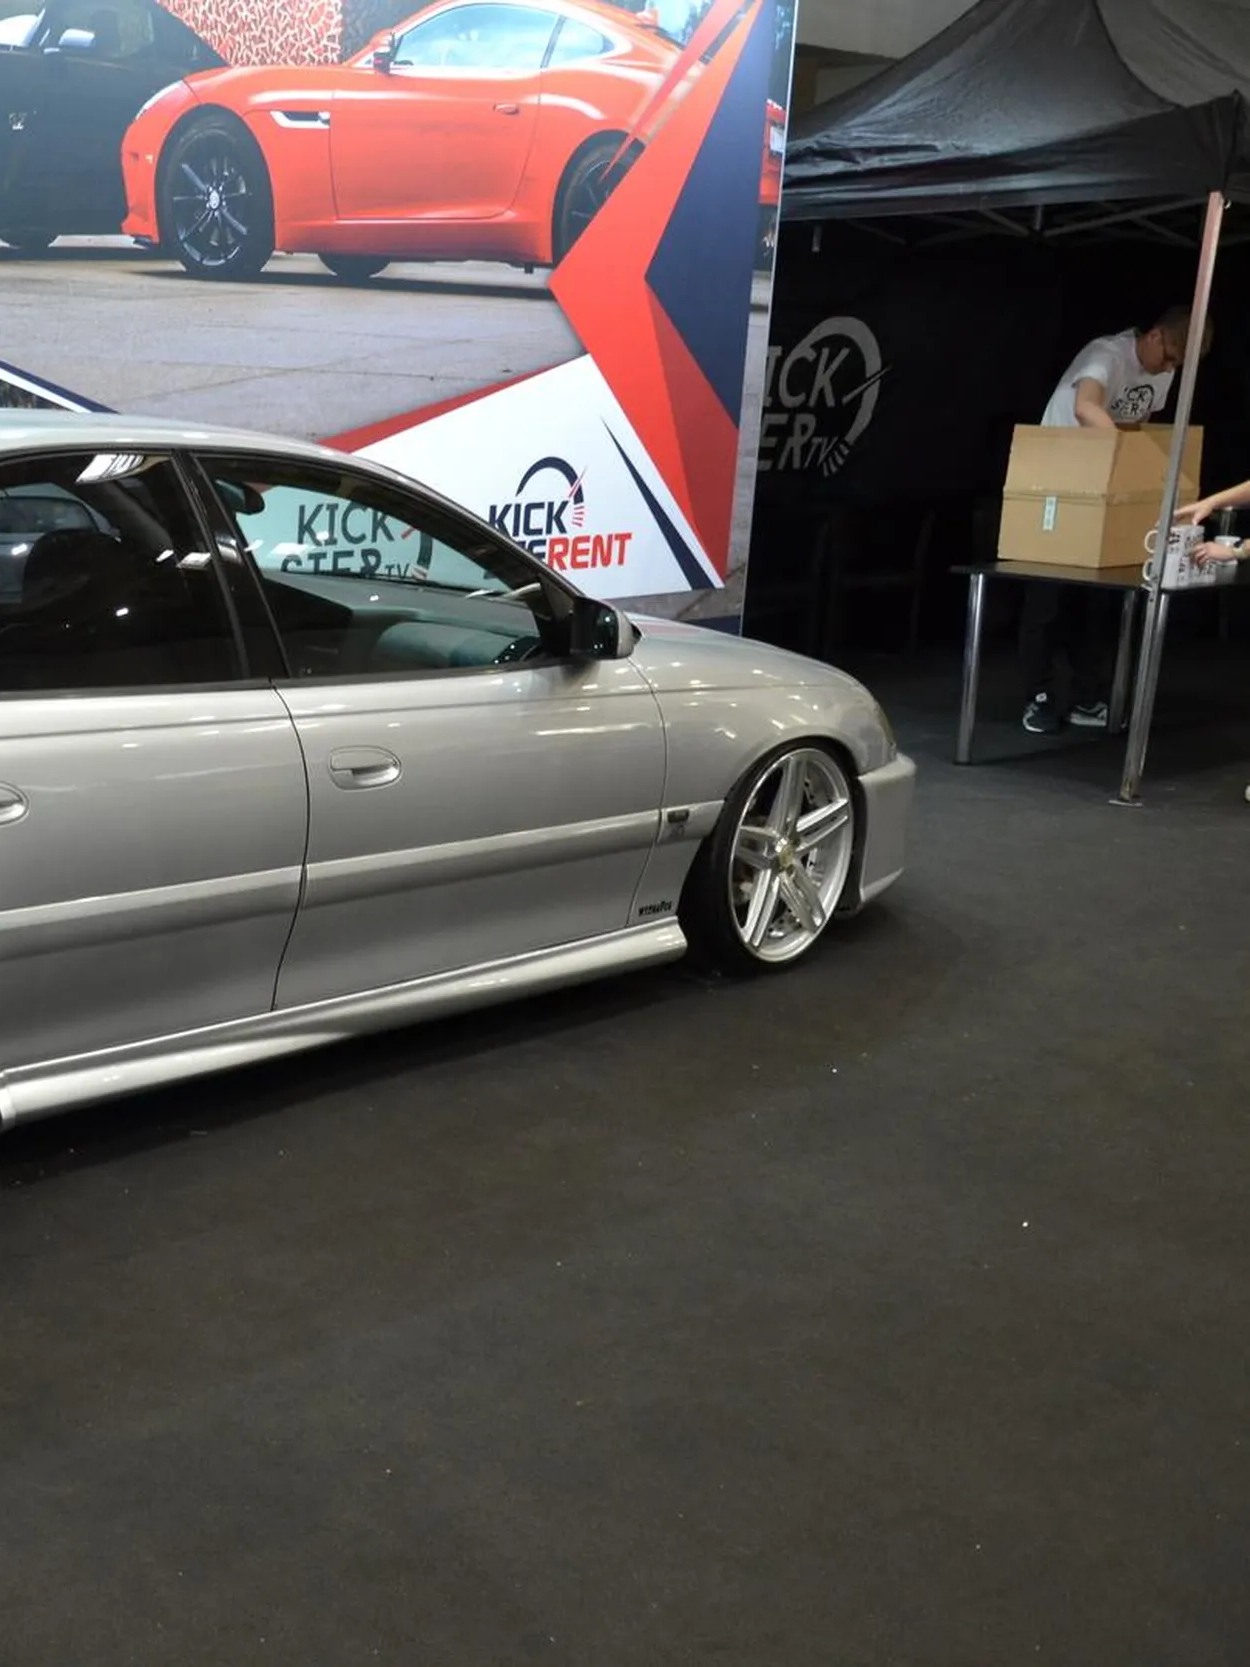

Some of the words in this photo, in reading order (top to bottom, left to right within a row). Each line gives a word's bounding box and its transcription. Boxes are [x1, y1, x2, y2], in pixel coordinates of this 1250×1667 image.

[762, 345, 850, 408] ICK
[757, 413, 816, 471] ER
[297, 501, 395, 546] KICK
[488, 500, 569, 537] KICK
